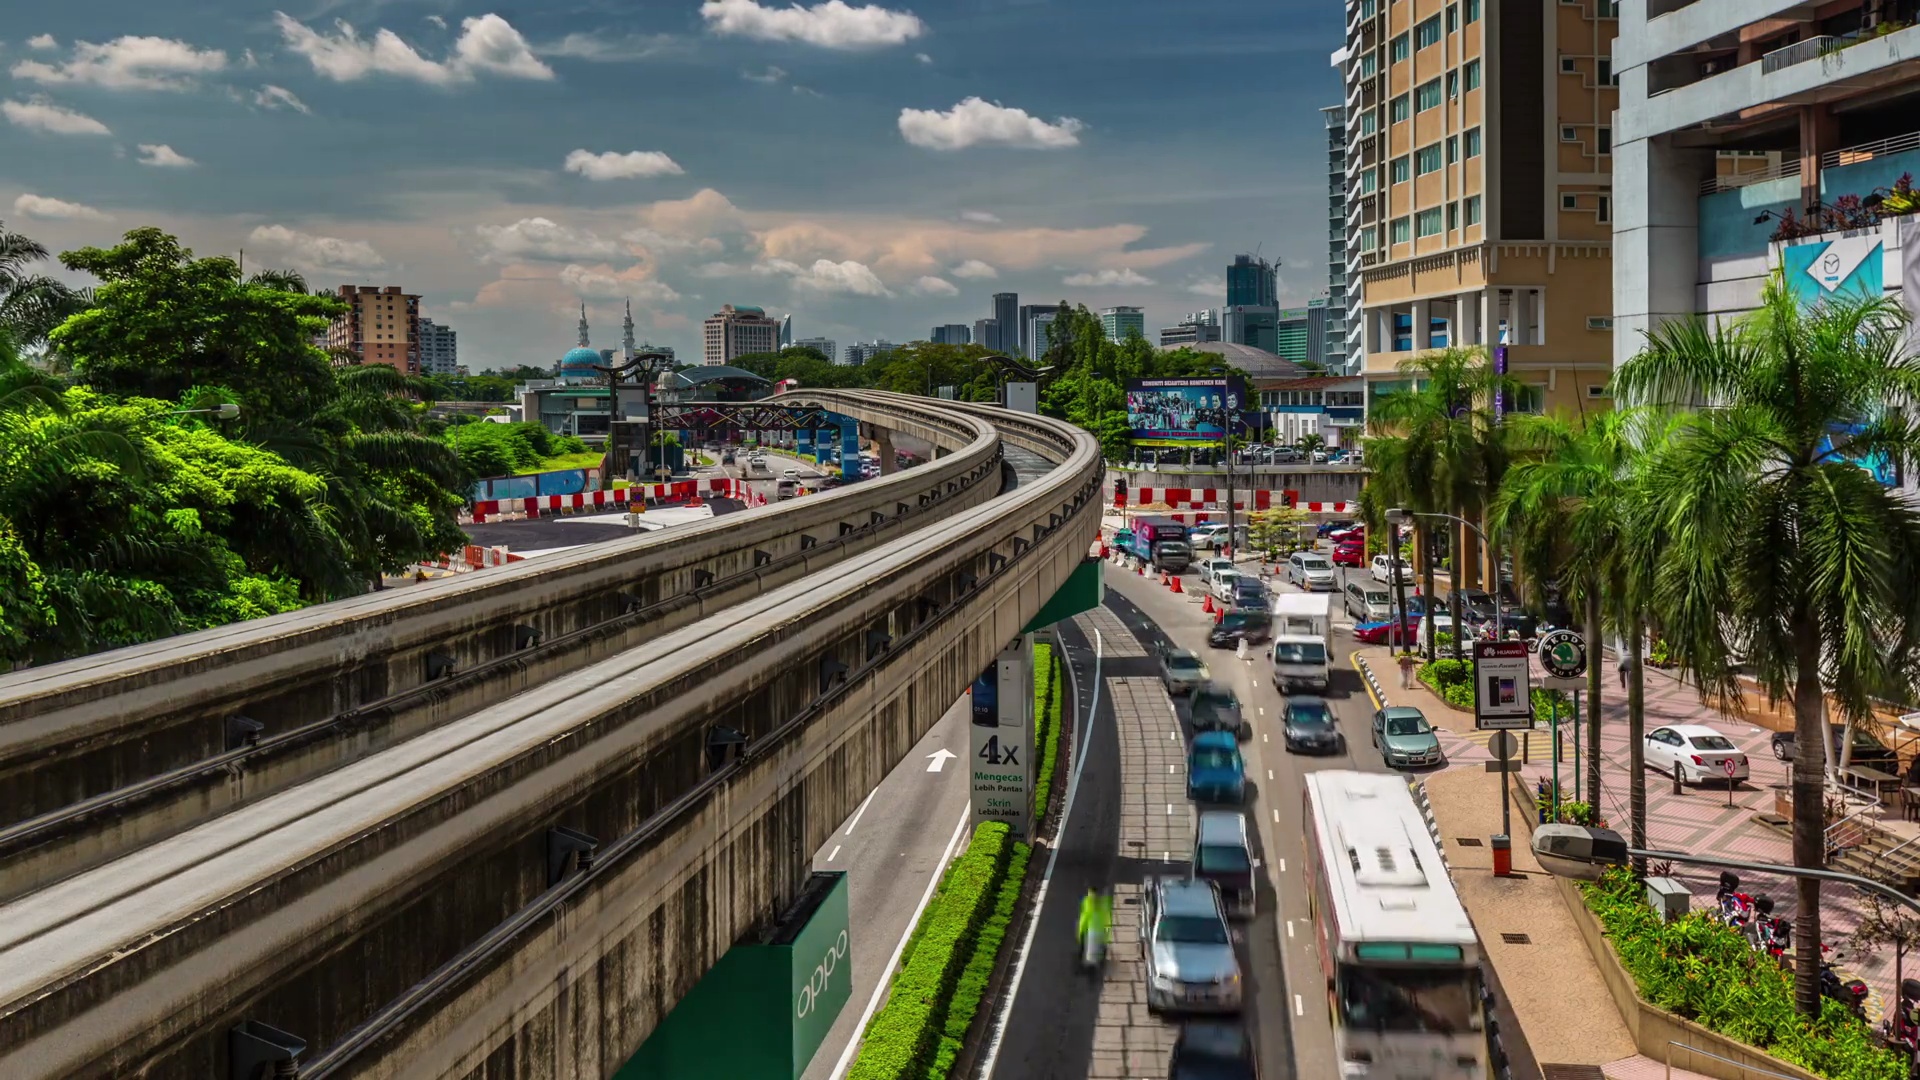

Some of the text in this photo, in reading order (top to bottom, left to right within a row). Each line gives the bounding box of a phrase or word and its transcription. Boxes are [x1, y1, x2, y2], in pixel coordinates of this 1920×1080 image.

[1545, 634, 1586, 651] SKODA
[1551, 667, 1581, 676] AUTO
[974, 771, 1023, 783] Mengecas
[974, 784, 1023, 793] Lebih Pantas
[987, 798, 1011, 808] Skrin
[978, 808, 1020, 817] Lebih Jelas
[797, 929, 848, 1019] oppo
